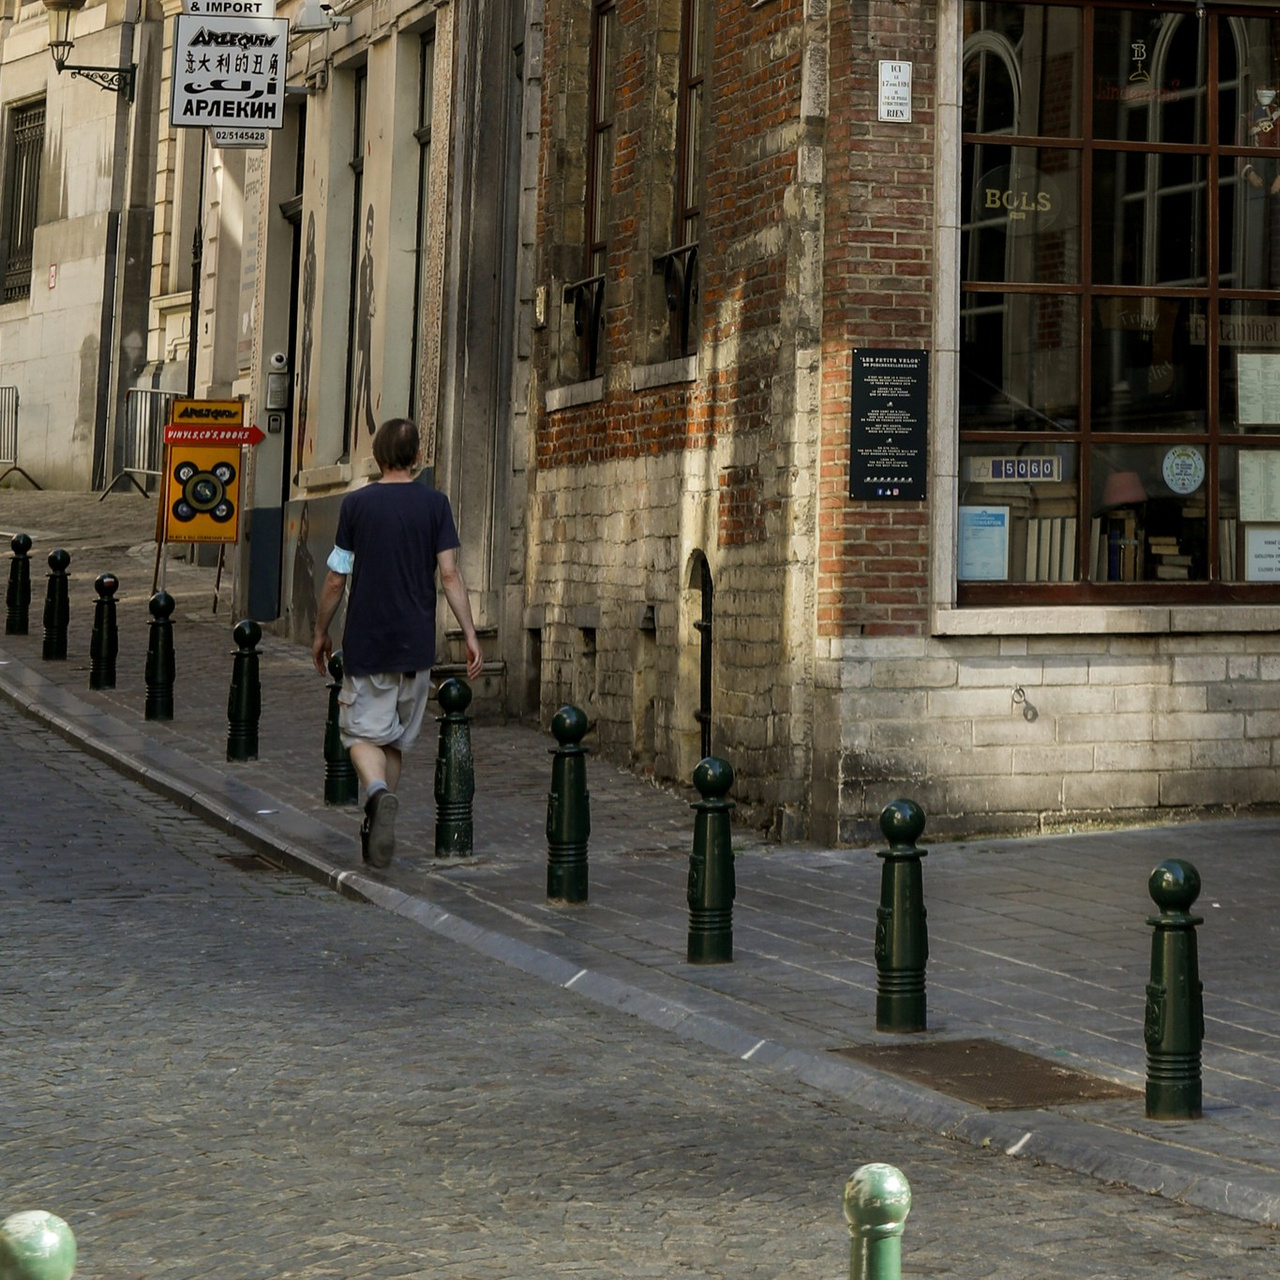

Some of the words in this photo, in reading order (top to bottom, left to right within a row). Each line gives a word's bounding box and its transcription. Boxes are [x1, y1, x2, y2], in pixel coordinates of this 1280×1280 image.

[190, 2, 200, 12] &
[206, 2, 263, 13] IMPORT
[185, 51, 278, 75] 意大利的丑角
[183, 99, 276, 119] АРЛЕКИН
[887, 109, 904, 118] RIEN
[216, 131, 265, 140] 02/5145428
[985, 188, 1052, 211] BOLS
[1193, 317, 1280, 342] Etaminet
[1006, 463, 1051, 474] 5060
